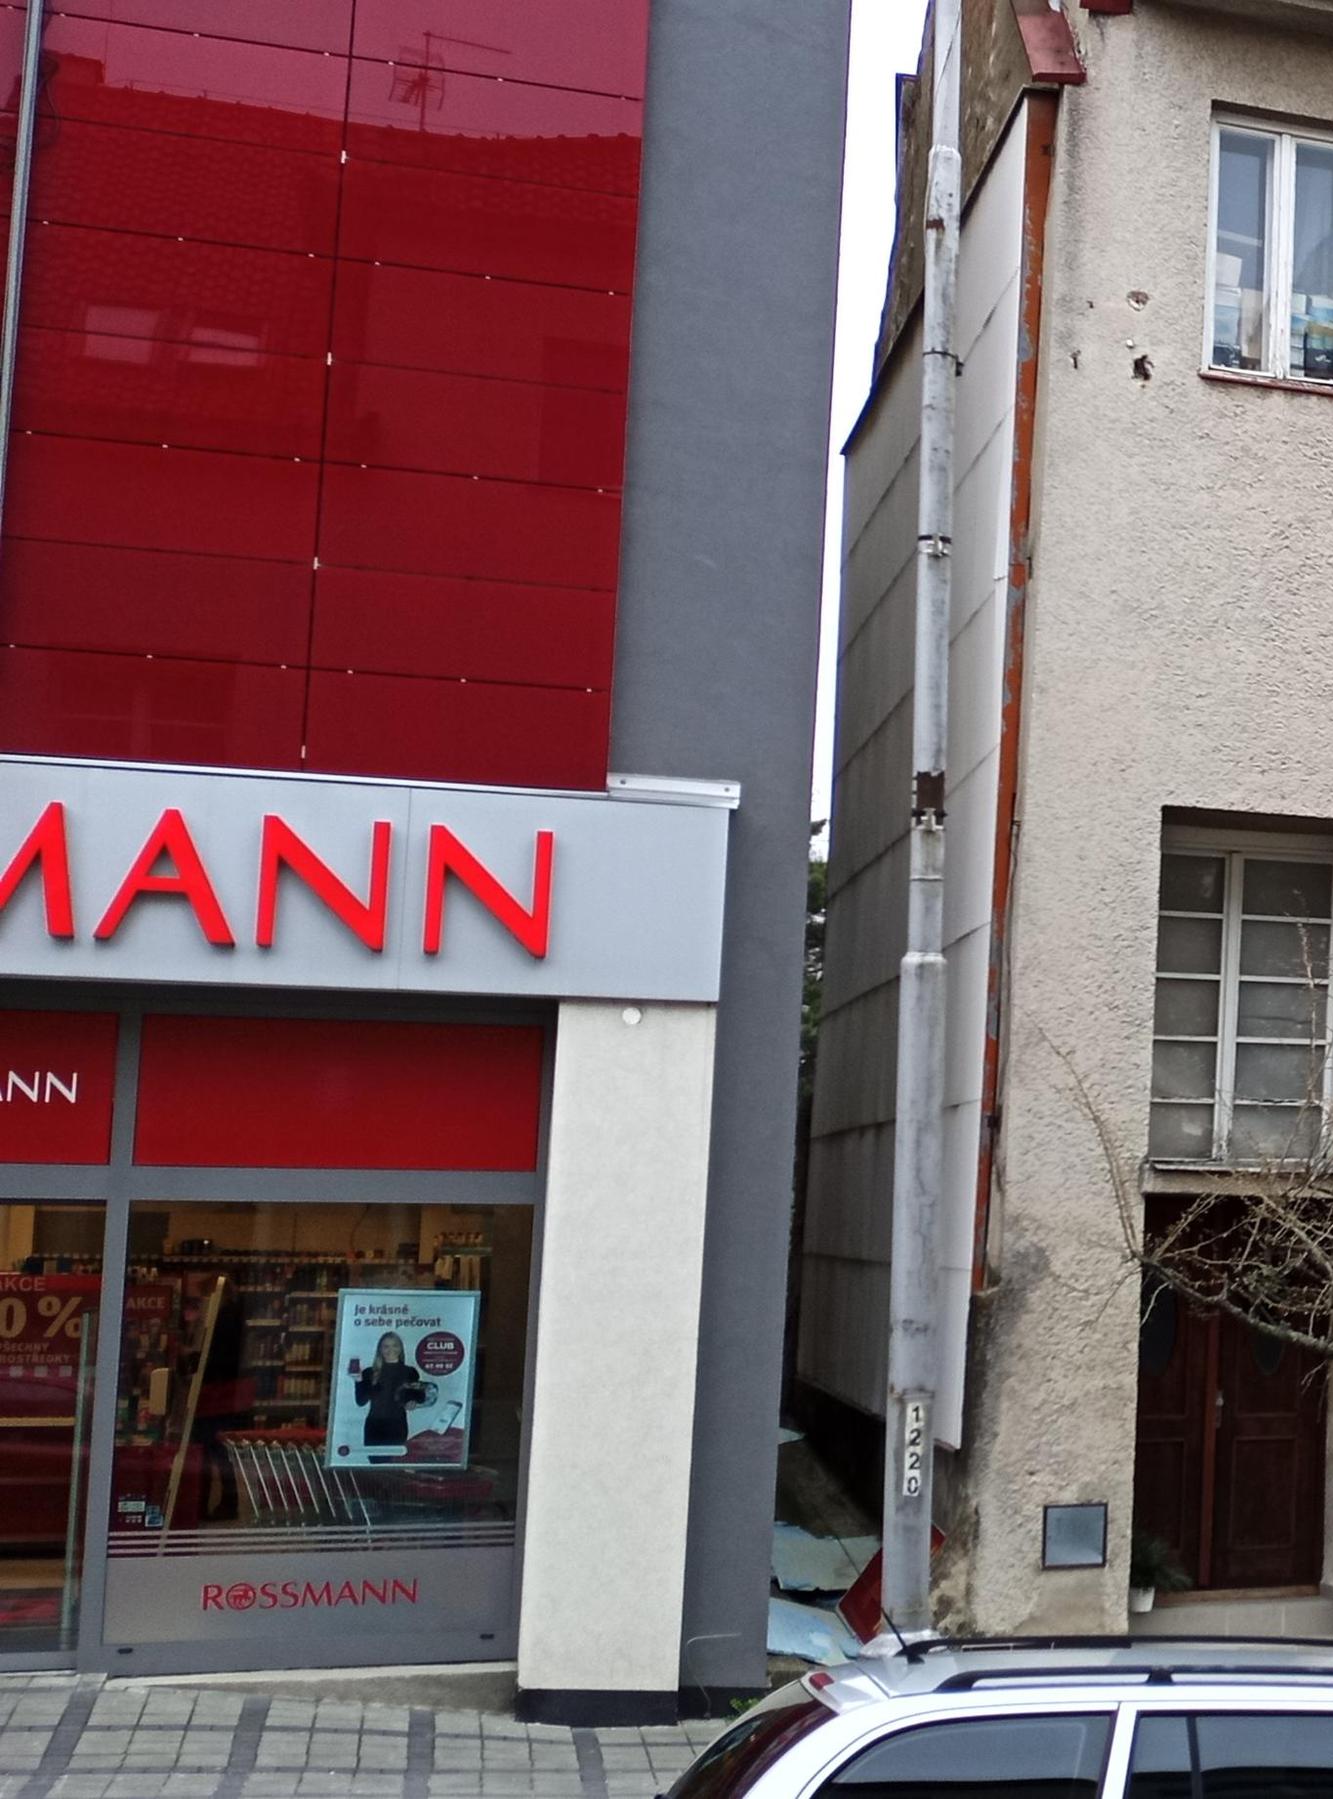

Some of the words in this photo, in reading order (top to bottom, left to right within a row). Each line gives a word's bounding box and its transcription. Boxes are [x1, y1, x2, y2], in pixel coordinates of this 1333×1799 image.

[0, 1070, 78, 1103] NN
[0, 1277, 46, 1292] KCE
[369, 1303, 409, 1315] krásně
[354, 1318, 361, 1326] o
[364, 1316, 392, 1326] sebe
[395, 1316, 441, 1328] pečovat
[426, 1342, 454, 1350] CLUB
[202, 1578, 419, 1611] ROSSMANN
